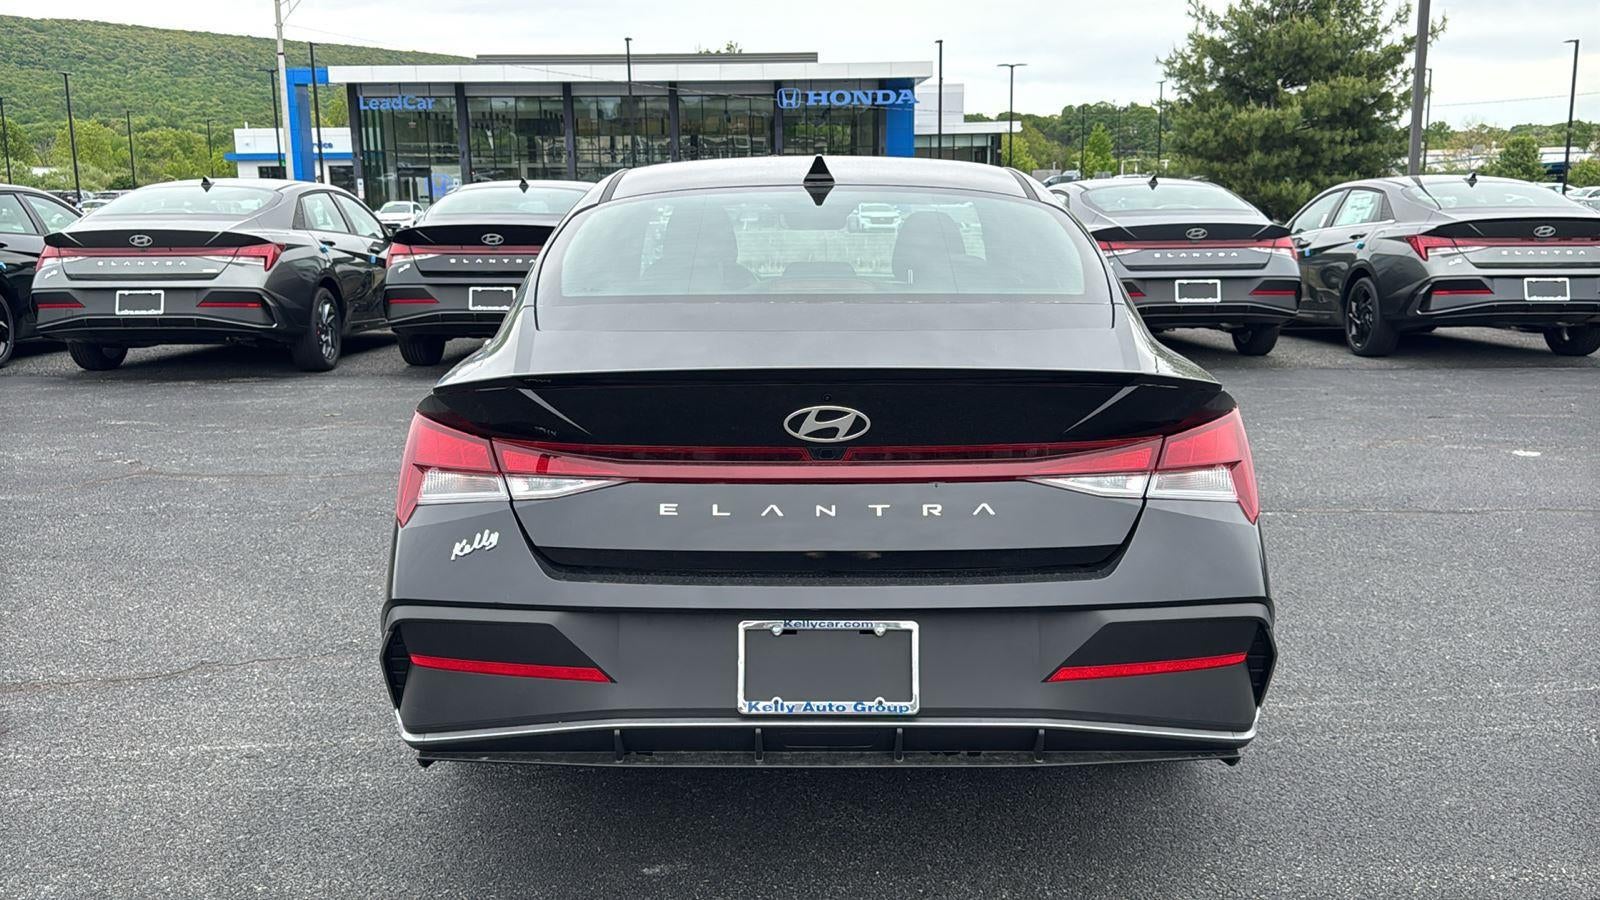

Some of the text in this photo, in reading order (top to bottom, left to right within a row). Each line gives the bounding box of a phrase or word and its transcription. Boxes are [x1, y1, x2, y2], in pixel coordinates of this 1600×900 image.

[358, 94, 436, 111] LeadCar
[805, 88, 919, 106] HONDA
[659, 502, 996, 517] ELANTRA
[450, 528, 499, 561] Kelly
[783, 619, 875, 629] Kellycar.com
[748, 701, 910, 714] Kelly Auto Group
